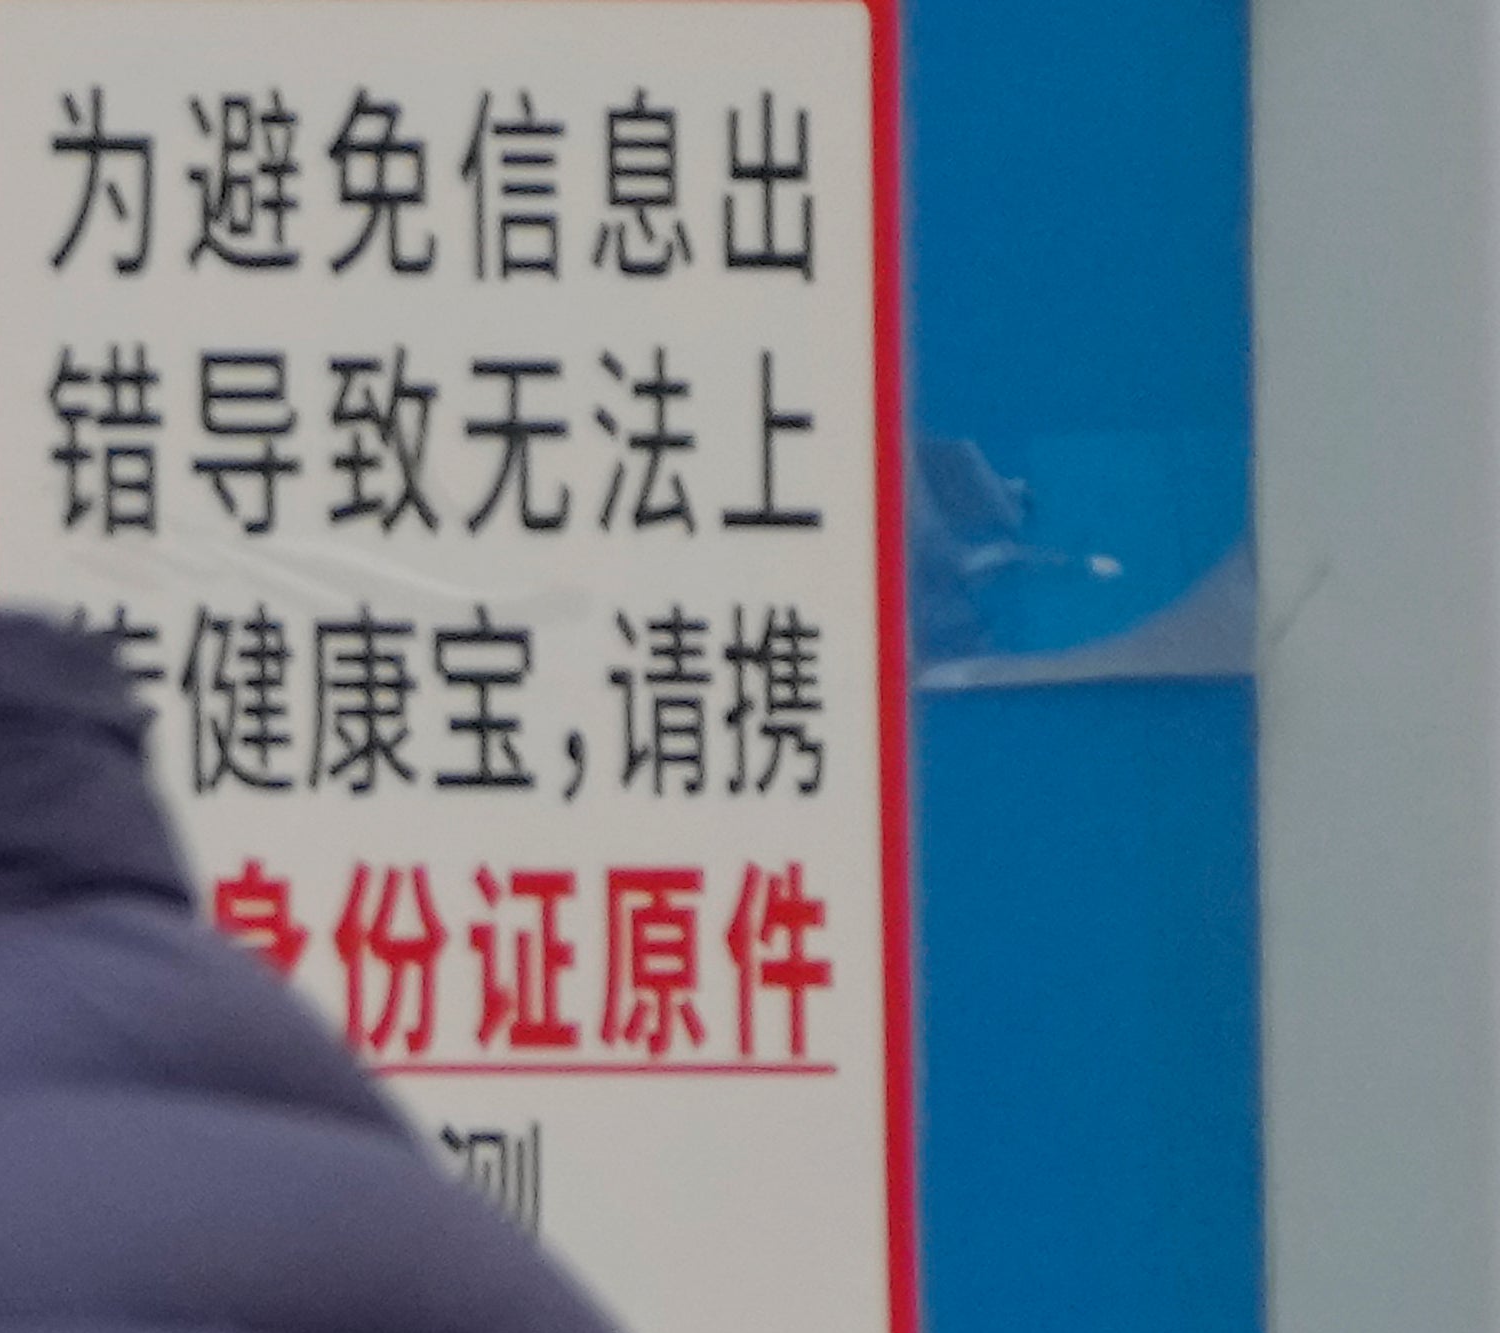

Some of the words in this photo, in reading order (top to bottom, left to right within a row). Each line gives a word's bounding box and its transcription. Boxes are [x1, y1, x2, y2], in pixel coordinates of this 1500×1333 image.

[50, 86, 816, 282] 为避免信息出
[48, 345, 822, 537] 错导致无法上
[76, 604, 825, 800] 健康宝，请携
